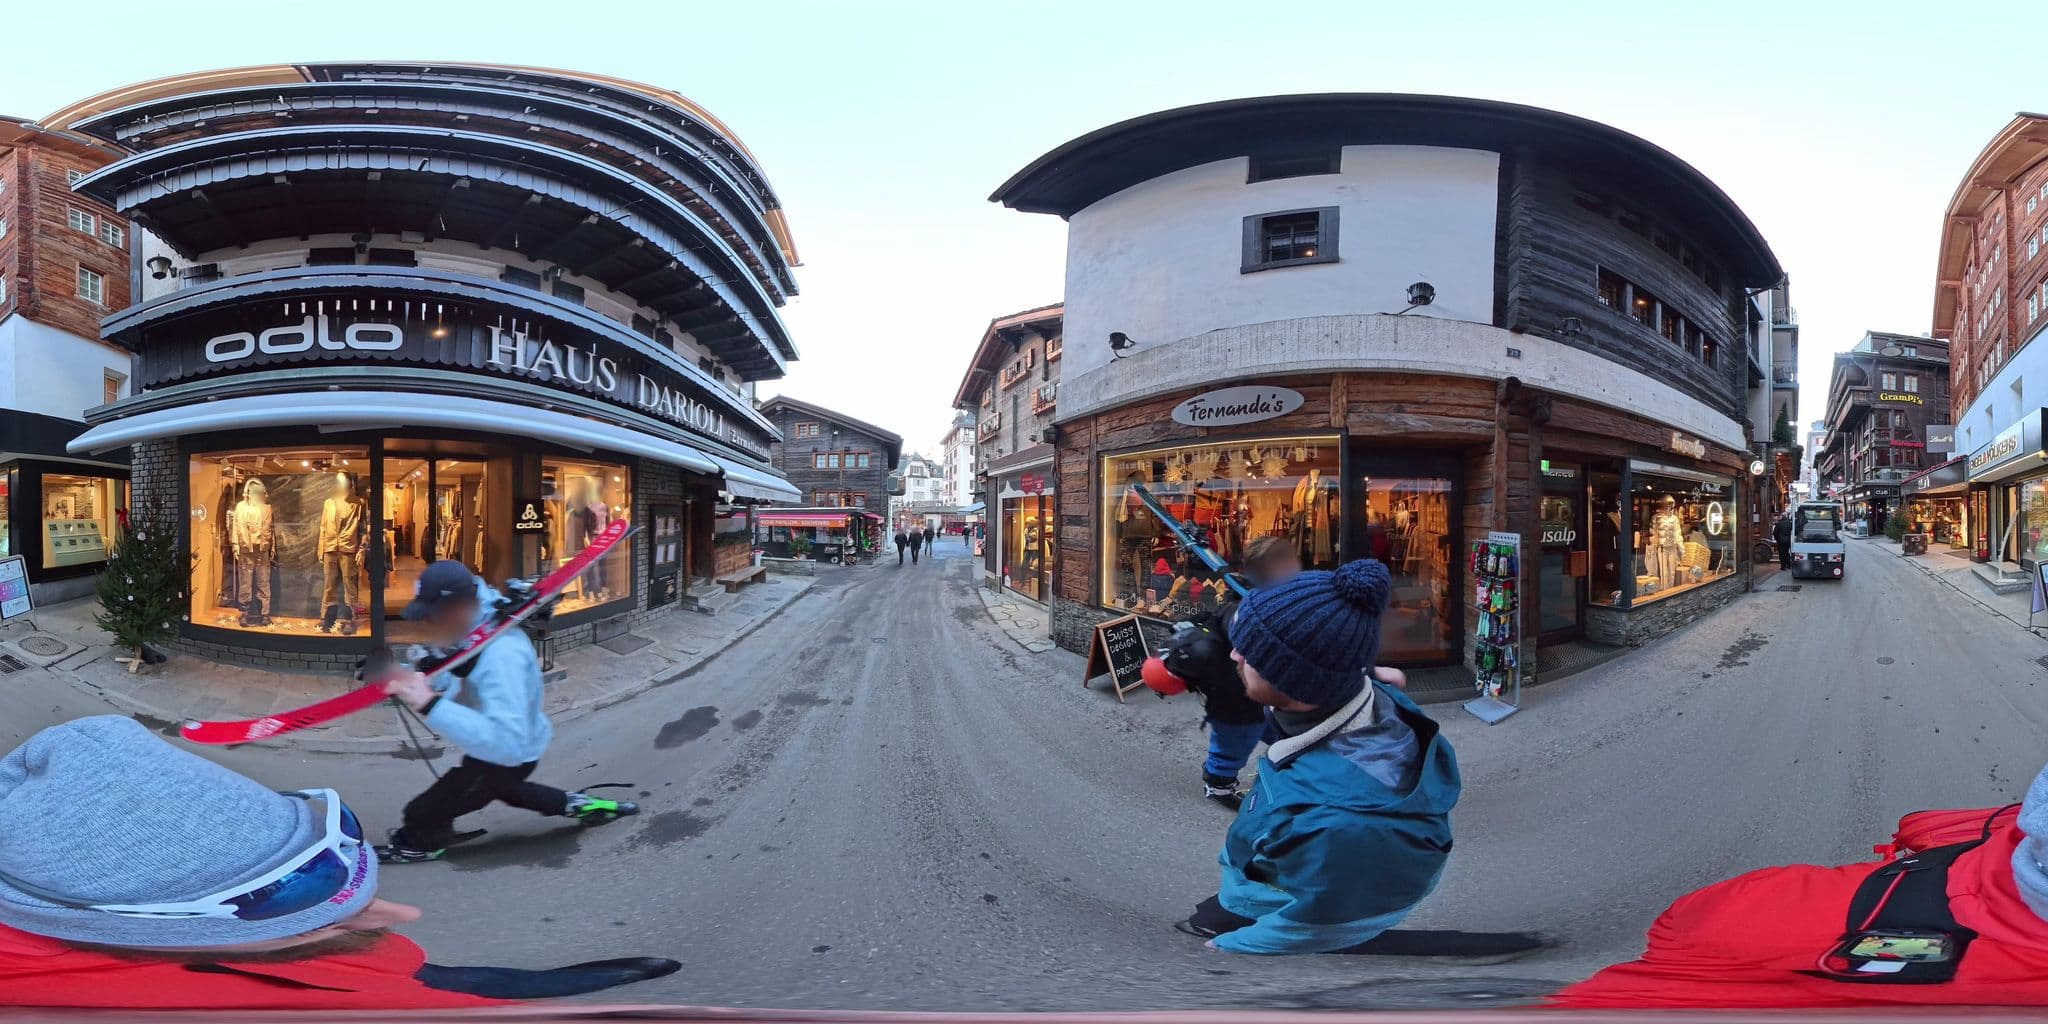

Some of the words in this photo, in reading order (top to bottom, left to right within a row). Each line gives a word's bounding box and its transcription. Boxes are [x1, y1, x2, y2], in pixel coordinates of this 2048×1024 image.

[206, 314, 403, 363] odlo
[486, 325, 617, 392] HAUS
[638, 373, 723, 437] DARIOLI
[1188, 394, 1284, 421] Fernanda's
[1880, 392, 1923, 406] Grampi's
[516, 521, 543, 529] odlo
